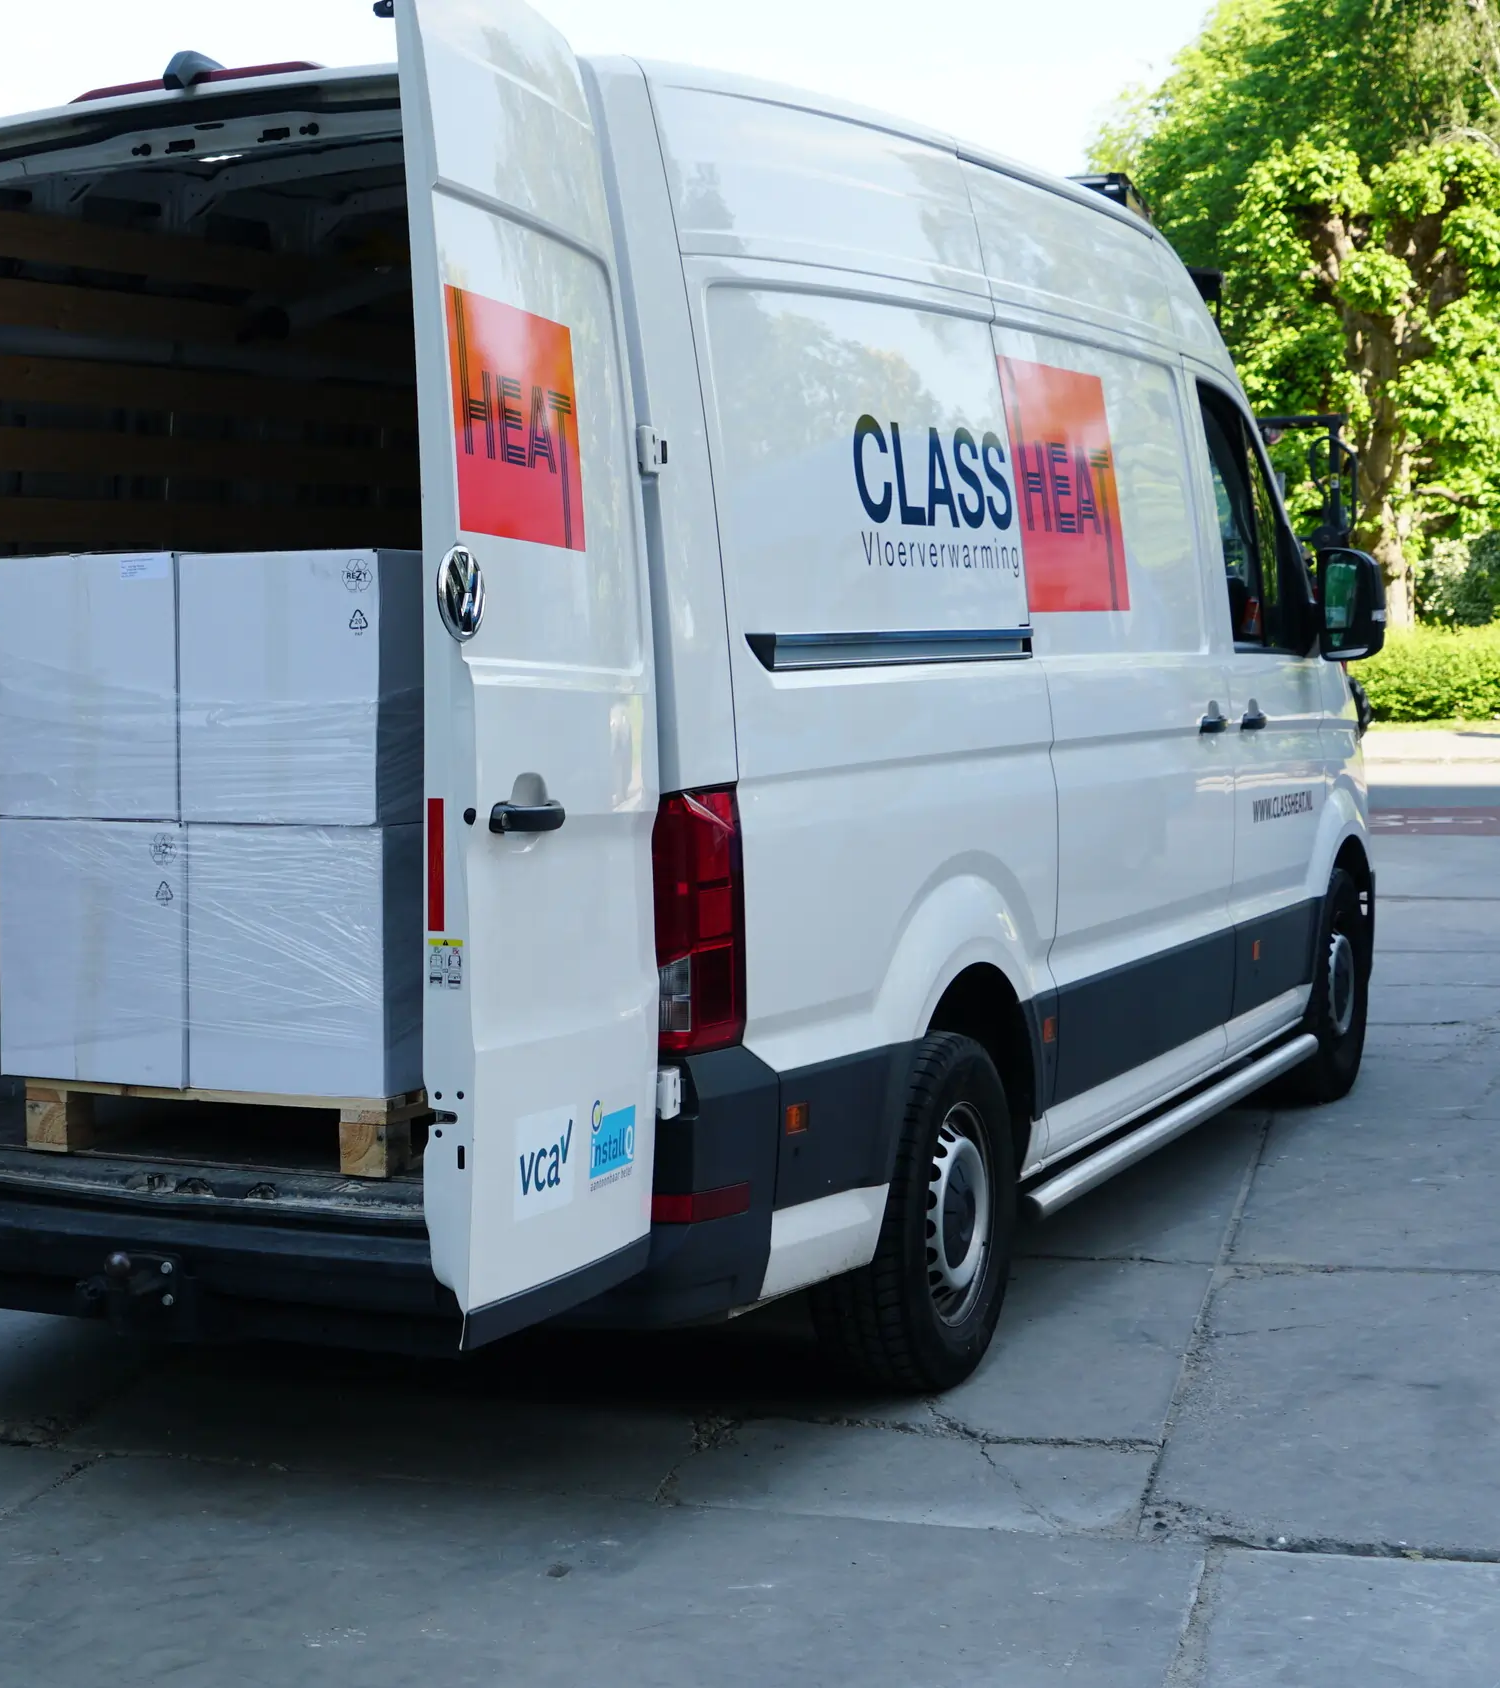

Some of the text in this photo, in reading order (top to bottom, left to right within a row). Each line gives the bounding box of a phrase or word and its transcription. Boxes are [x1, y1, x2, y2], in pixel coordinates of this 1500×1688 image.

[453, 287, 571, 549] HEAT
[853, 357, 1119, 611] CLASS HEAT
[346, 570, 368, 581] REZY
[861, 530, 1020, 578] Vloerverwarming
[1252, 790, 1313, 823] WWW.CLASSHEAT.NL
[591, 1125, 634, 1169] installQ
